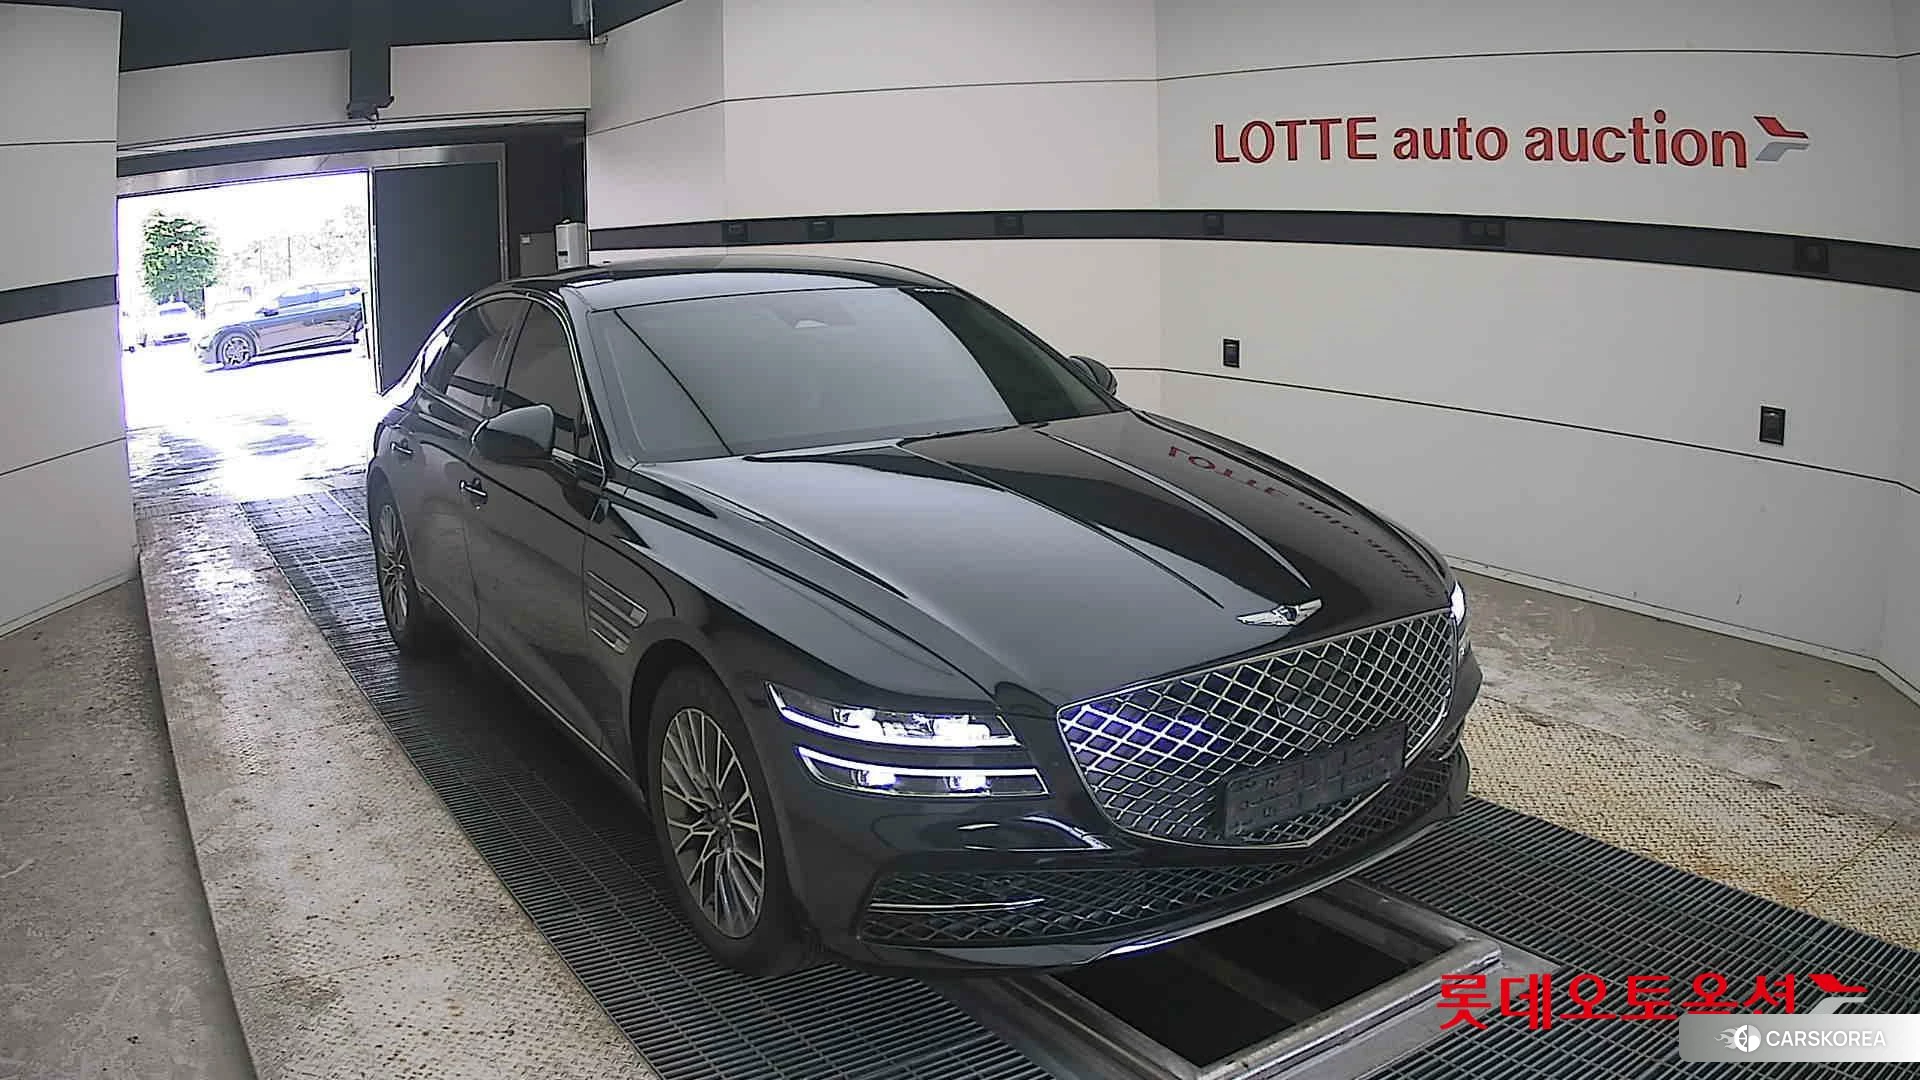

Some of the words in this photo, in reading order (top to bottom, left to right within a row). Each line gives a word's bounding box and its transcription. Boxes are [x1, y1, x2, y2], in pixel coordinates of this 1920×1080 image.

[1215, 117, 1379, 164] LOTTE
[1394, 118, 1509, 162] auto
[1525, 109, 1749, 169] auction
